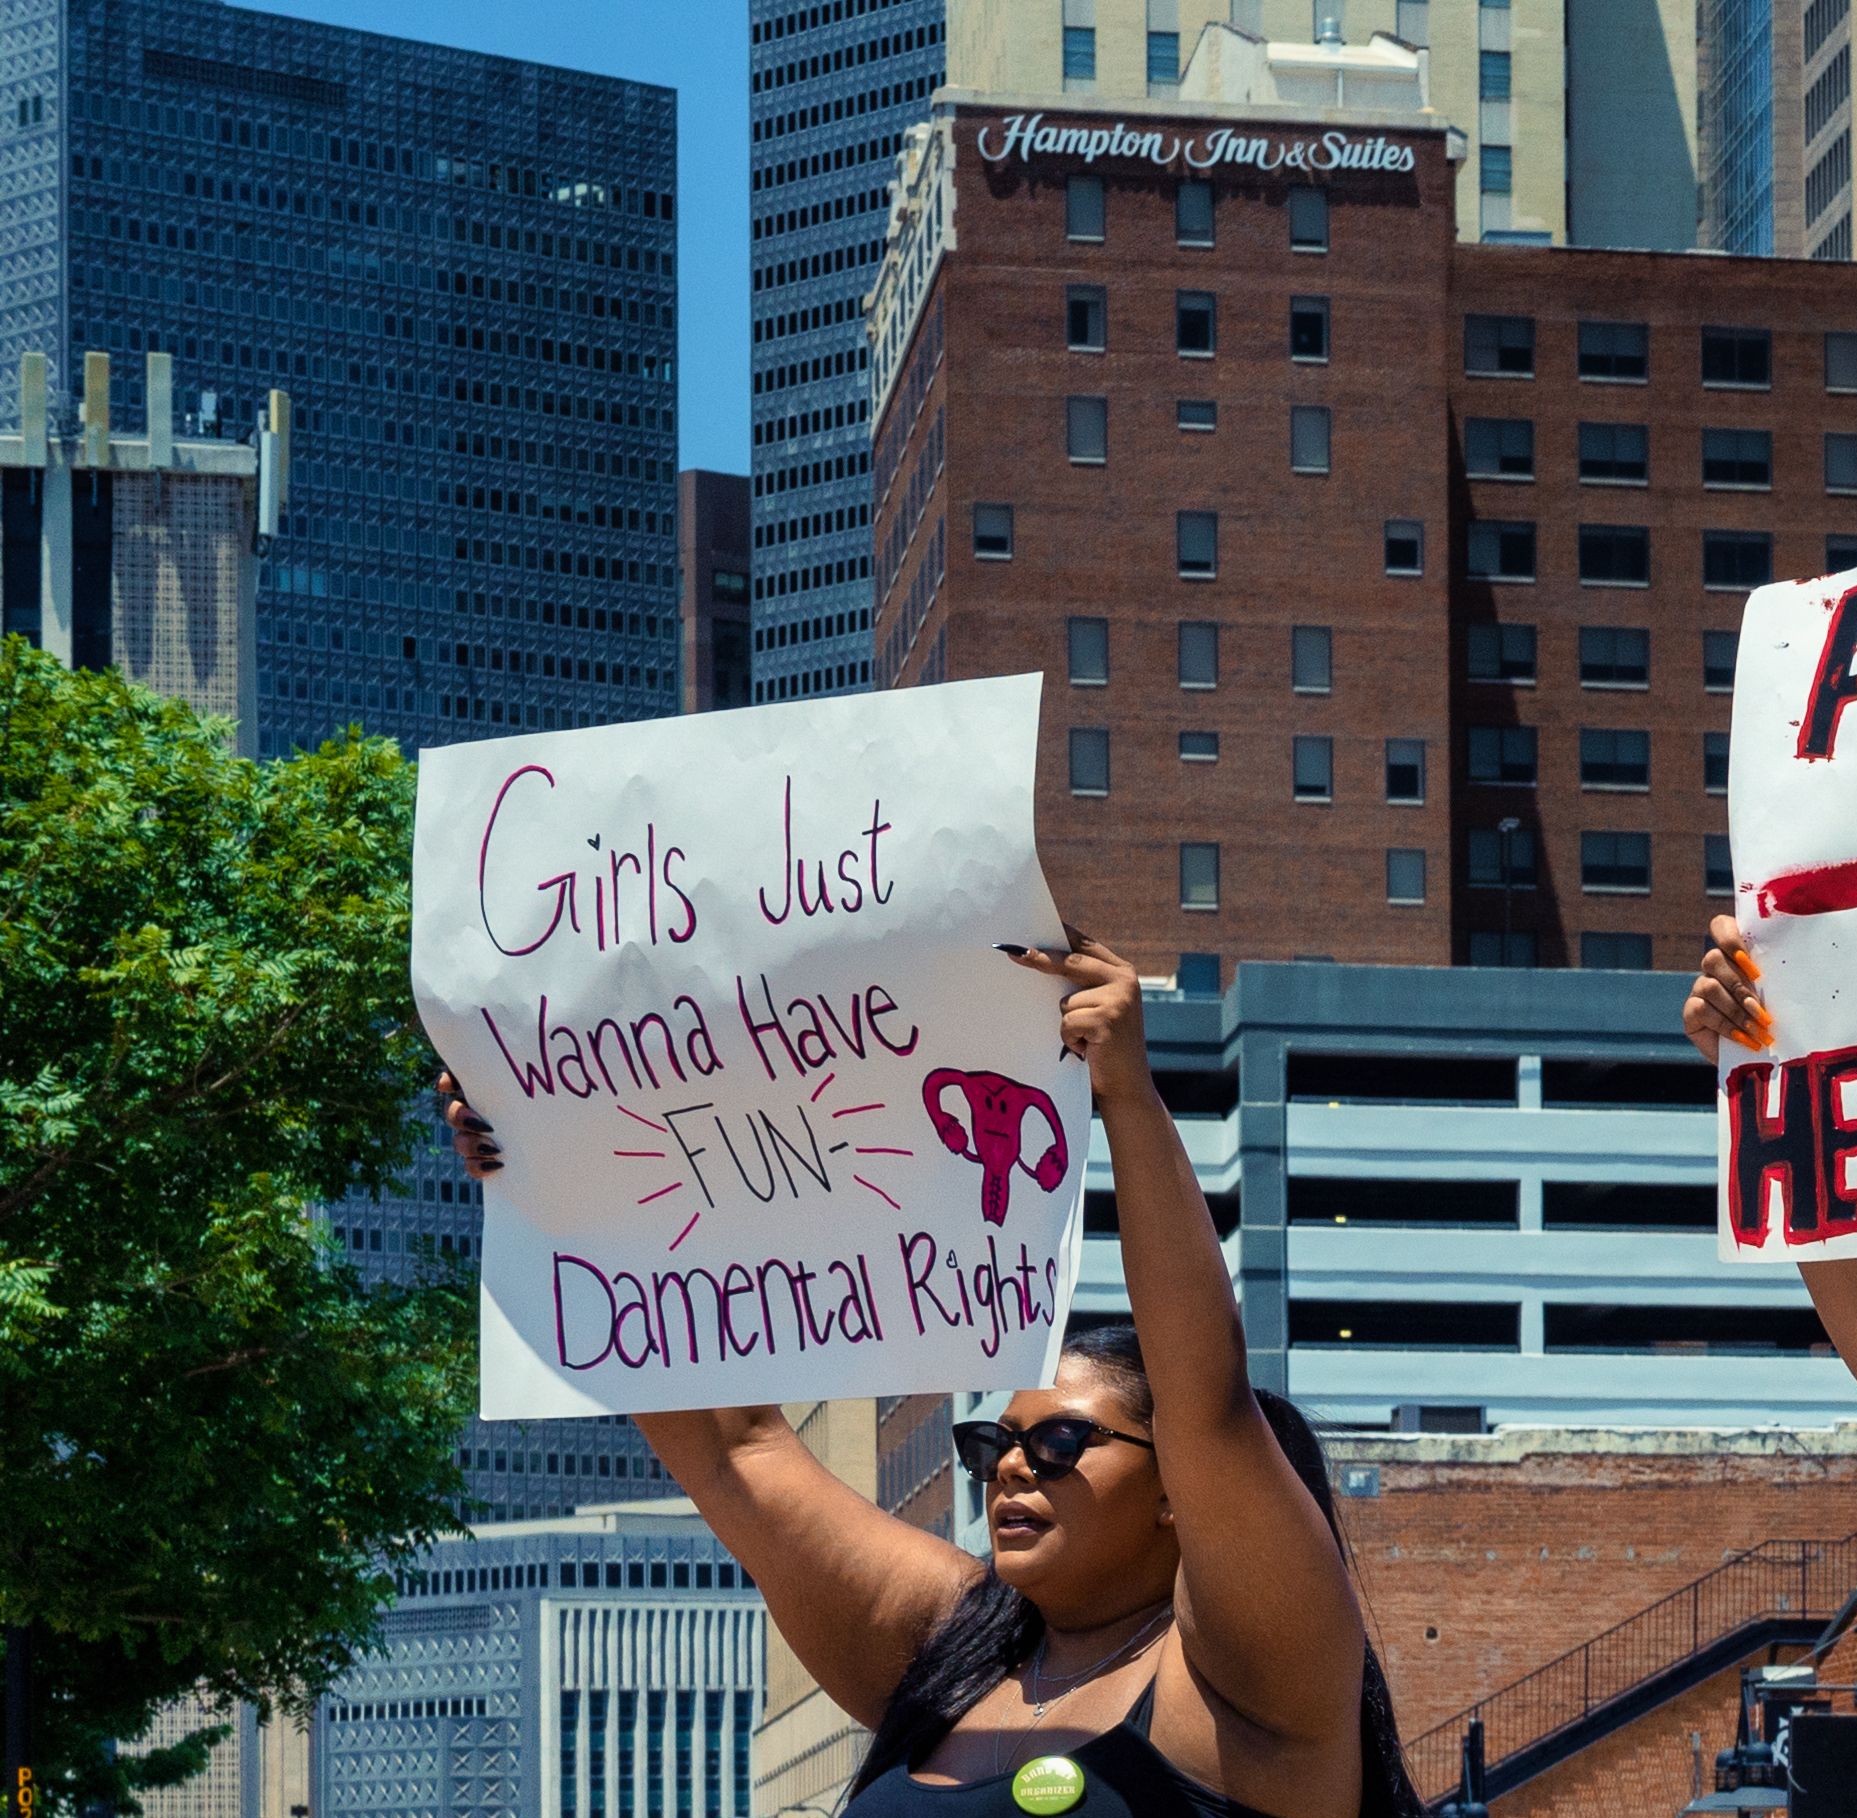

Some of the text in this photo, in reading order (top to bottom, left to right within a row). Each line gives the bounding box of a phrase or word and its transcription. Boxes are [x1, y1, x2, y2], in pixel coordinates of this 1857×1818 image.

[977, 113, 1416, 173] Hampton Inn & Suites
[480, 765, 894, 957] Girls Just
[480, 973, 920, 1099] Wanna Have
[554, 1231, 1058, 1372] Damental Rights
